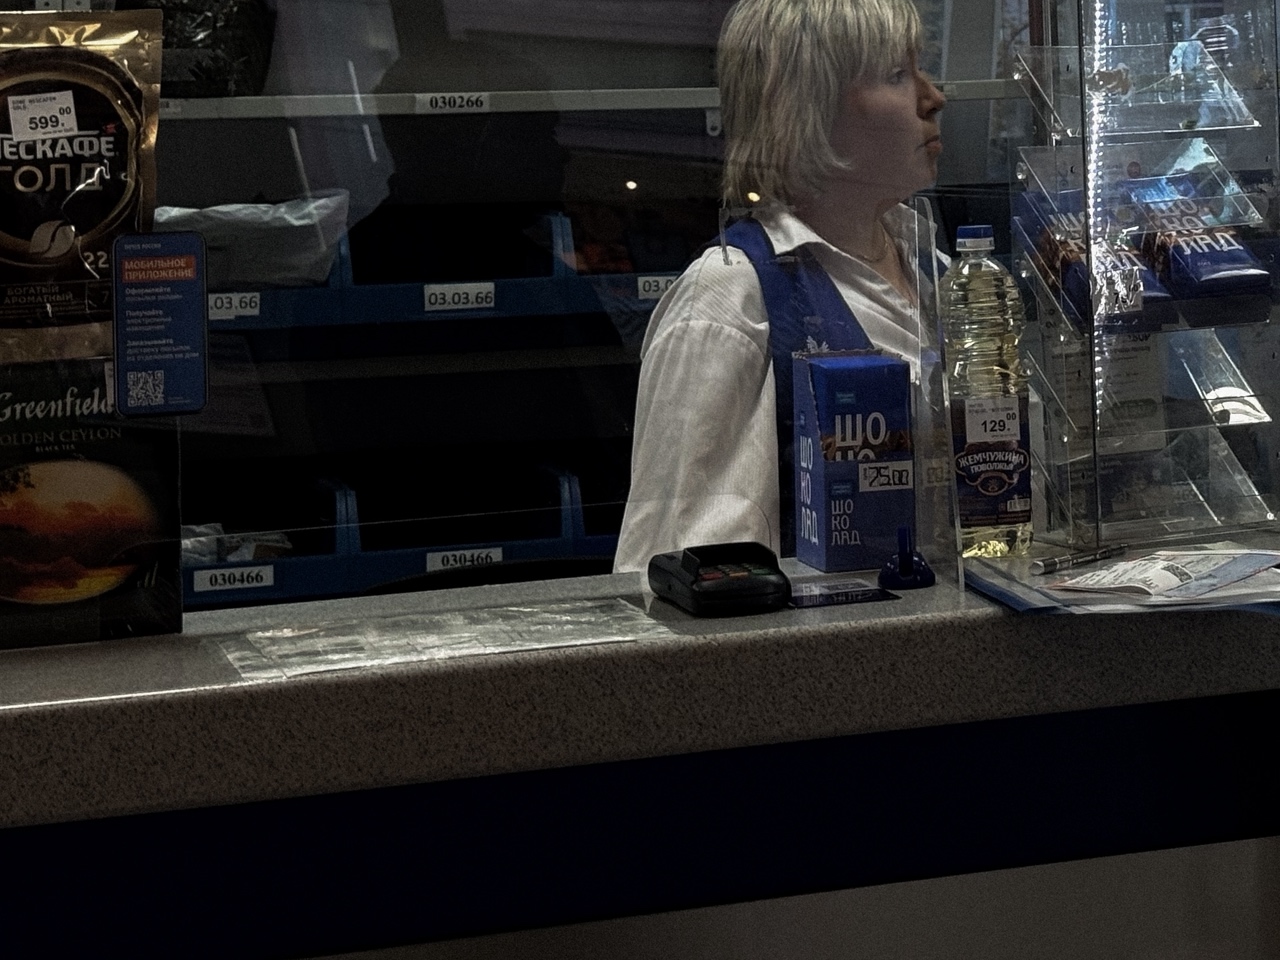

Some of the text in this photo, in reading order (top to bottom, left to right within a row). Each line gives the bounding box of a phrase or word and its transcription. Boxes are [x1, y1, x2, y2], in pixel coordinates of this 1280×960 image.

[430, 95, 483, 109] 030266
[0, 136, 115, 160] ЕСКАФЕ
[1178, 232, 1243, 255] ЛАД
[125, 258, 187, 270] МОБИЛЬНОЕ
[125, 268, 193, 280] ПРИЛОЖЕНИЕ
[428, 290, 494, 308] 03.03.66
[59, 427, 122, 442] CEYLON
[835, 411, 887, 447] ШО
[958, 451, 1024, 468] ЖЕМЧУЖИНА
[831, 499, 854, 515] ШО
[801, 507, 818, 546] ЛАД
[831, 515, 849, 530] КО
[831, 530, 861, 546] ЛАД
[441, 553, 493, 567] 030466
[210, 572, 263, 587] 030466
